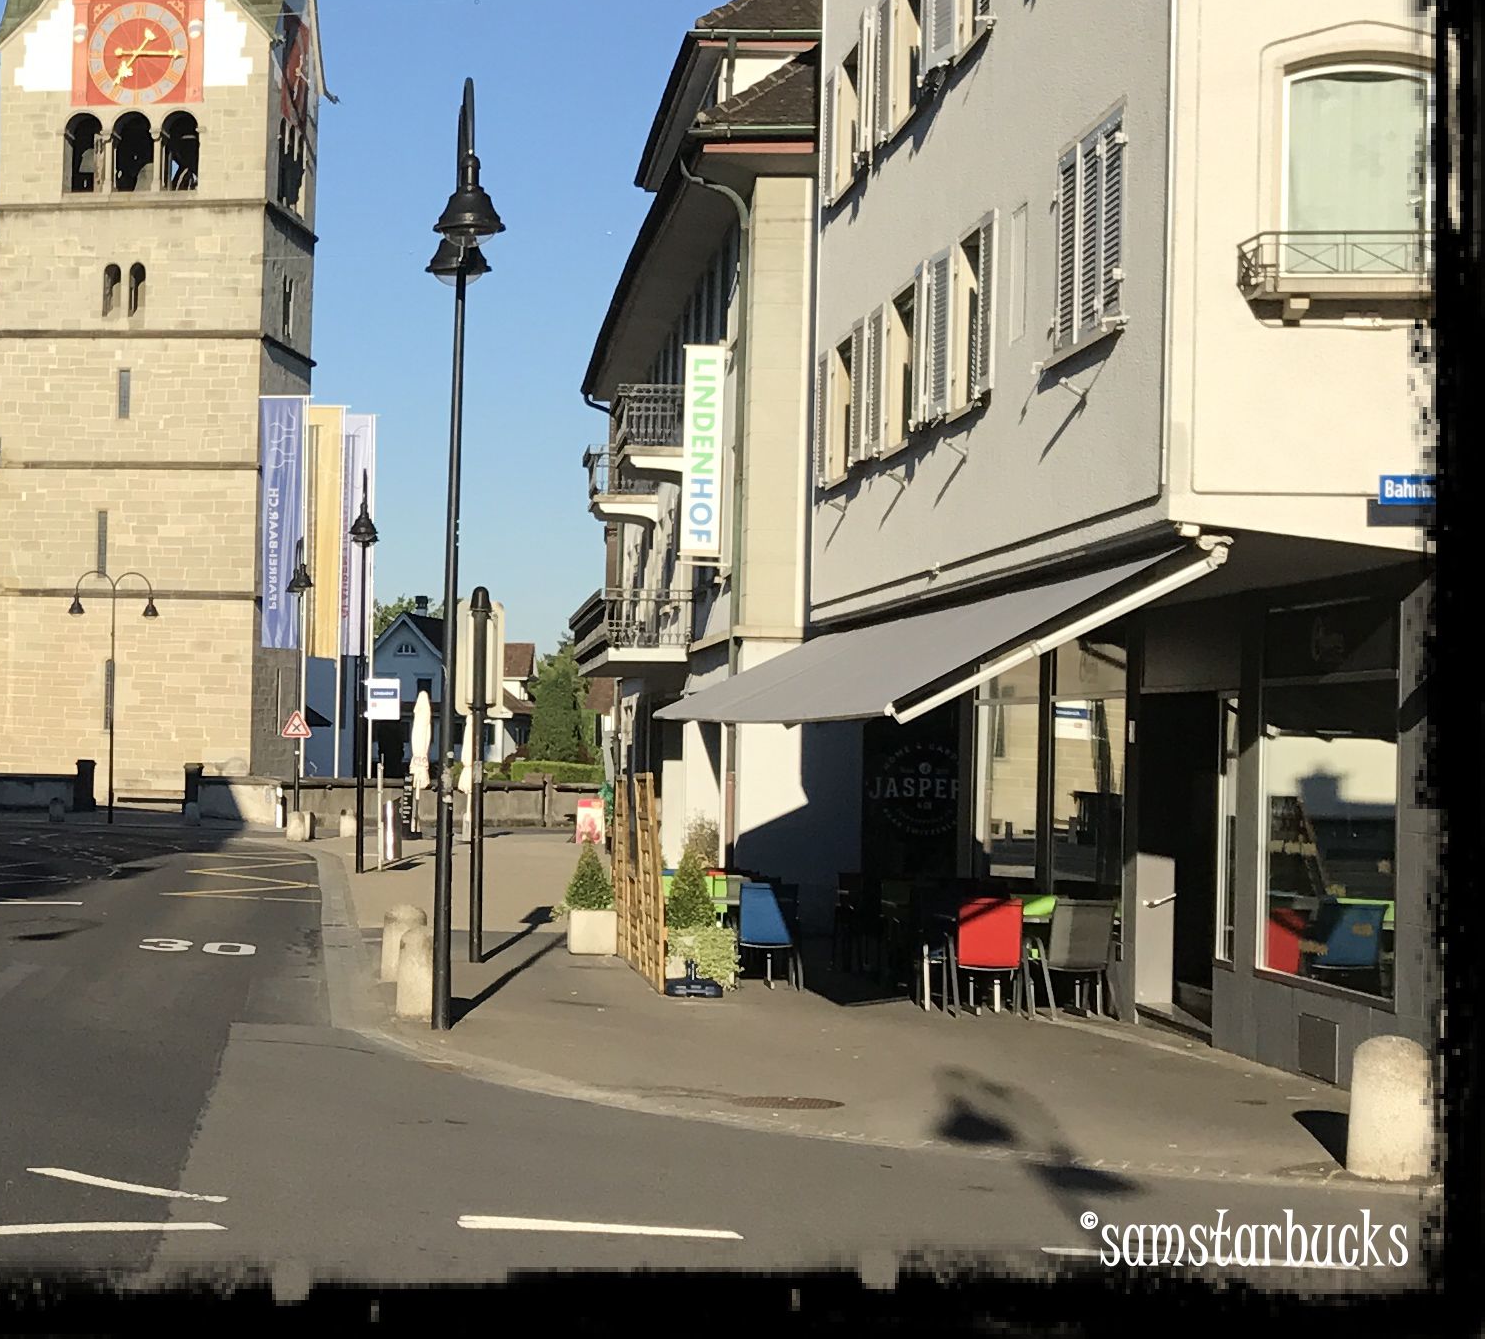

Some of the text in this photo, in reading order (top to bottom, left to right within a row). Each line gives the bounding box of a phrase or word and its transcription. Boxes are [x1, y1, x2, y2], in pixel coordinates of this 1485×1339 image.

[689, 358, 717, 543] LINDENHOF
[1384, 478, 1436, 498] Bahnh
[139, 938, 257, 956] 30
